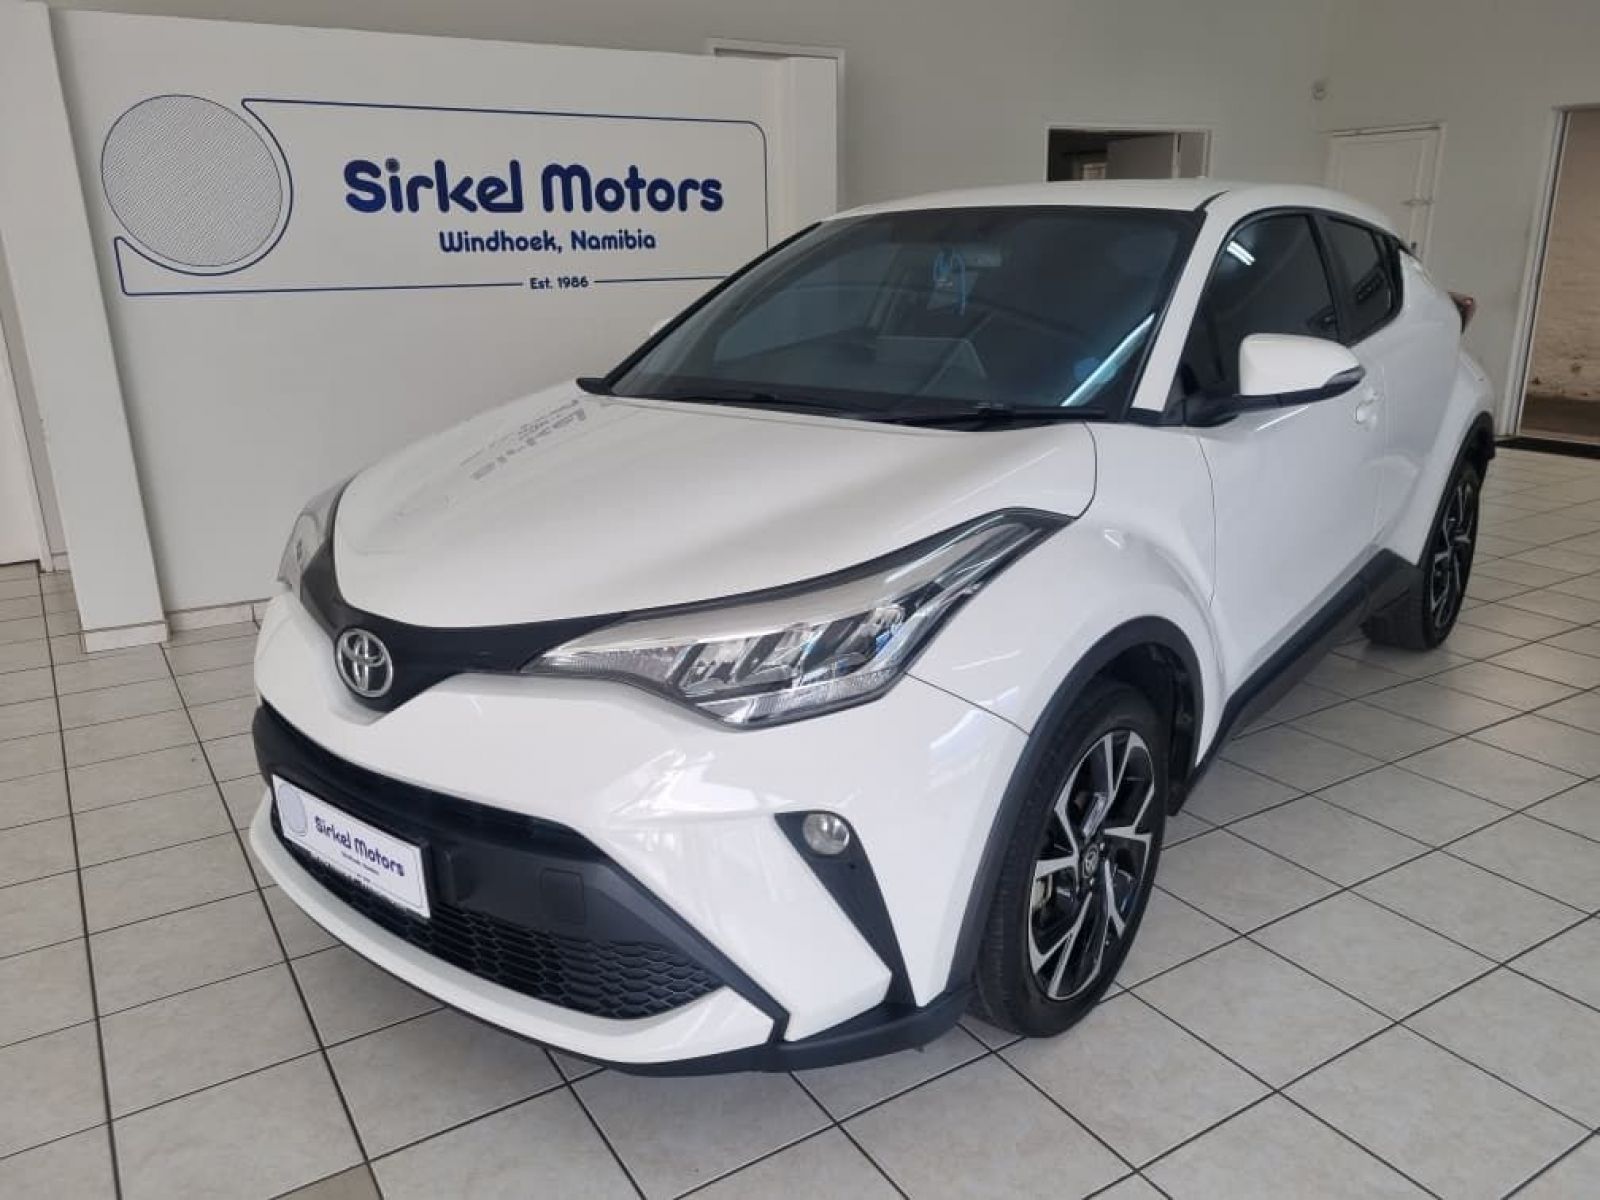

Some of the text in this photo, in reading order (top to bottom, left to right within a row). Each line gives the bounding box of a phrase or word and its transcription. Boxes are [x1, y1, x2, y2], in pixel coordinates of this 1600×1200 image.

[343, 157, 725, 214] Sirkel Motors
[438, 229, 657, 254] Windhoek, Namibia
[529, 275, 590, 290] Est. 1986
[315, 815, 351, 849] Sirkel
[353, 837, 404, 876] Motors
